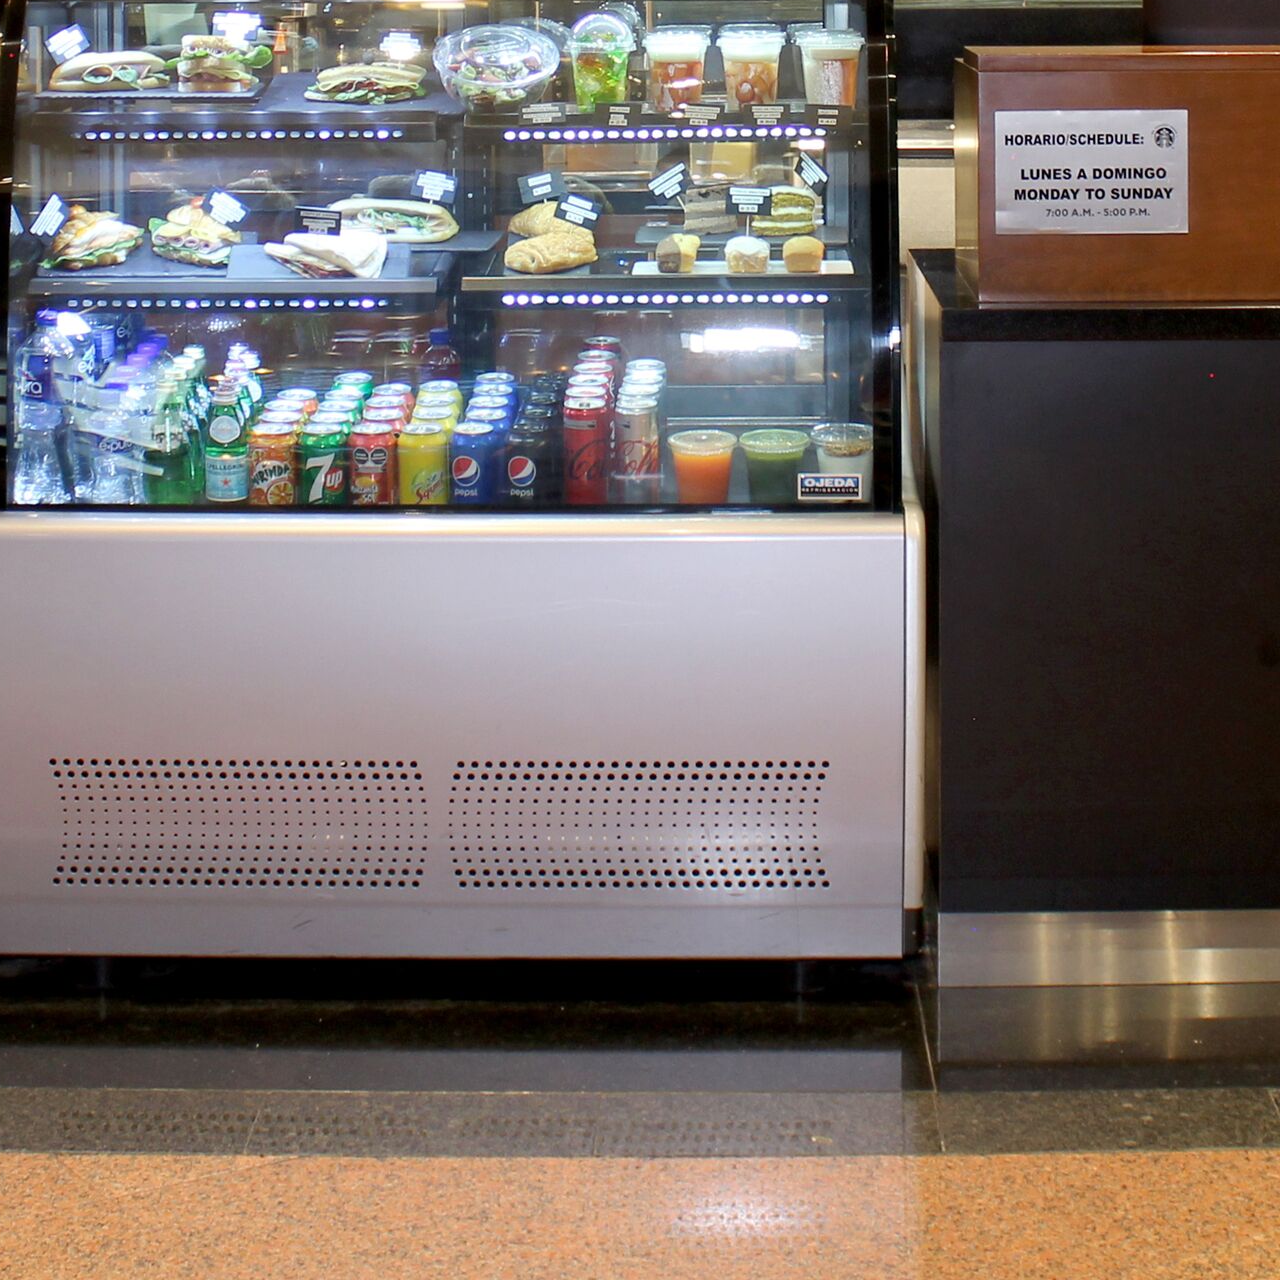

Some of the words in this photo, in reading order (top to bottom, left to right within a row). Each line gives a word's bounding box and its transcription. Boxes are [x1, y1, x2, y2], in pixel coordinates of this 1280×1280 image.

[1004, 133, 1145, 146] HORARIO/SCHEDULE:
[1020, 168, 1072, 180] LUNES
[1077, 168, 1090, 180] A
[1092, 167, 1167, 180] DOMINGO
[1014, 188, 1080, 200] MONDAY
[1085, 188, 1106, 200] TO
[1111, 187, 1174, 199] SUNDAY
[1045, 208, 1069, 217] 7:00
[1071, 208, 1095, 217] A.M.
[1103, 208, 1127, 216] 5:00
[1129, 208, 1151, 216] P.M.
[803, 478, 855, 487] OJEDA
[454, 487, 478, 497] pepsi
[510, 487, 534, 497] pepsi
